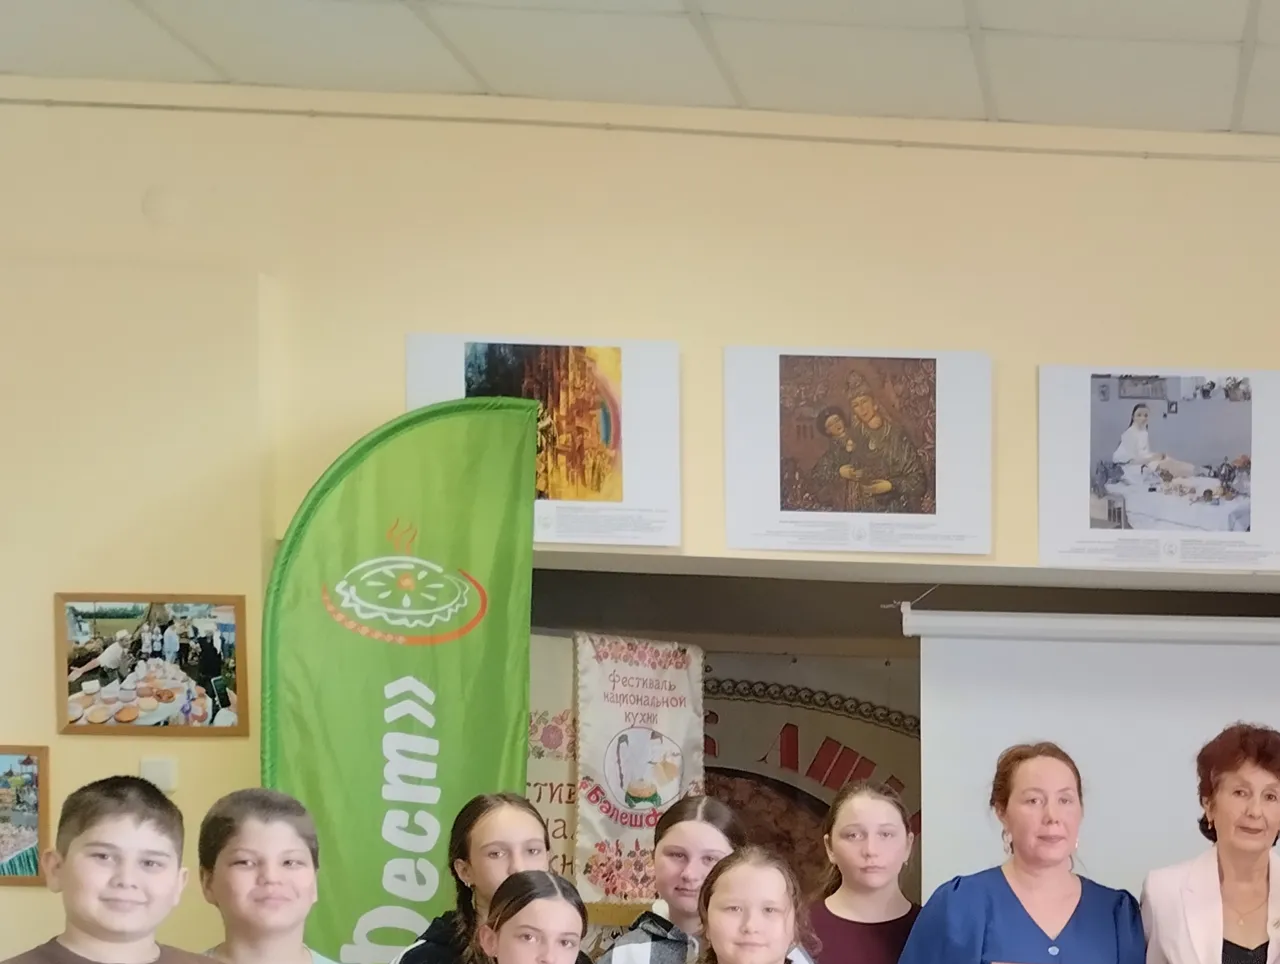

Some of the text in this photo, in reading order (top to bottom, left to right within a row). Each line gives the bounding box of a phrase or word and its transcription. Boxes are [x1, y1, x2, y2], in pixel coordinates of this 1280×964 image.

[608, 669, 677, 691] фестиваль
[603, 690, 687, 708] национальной
[624, 711, 659, 728] кухни
